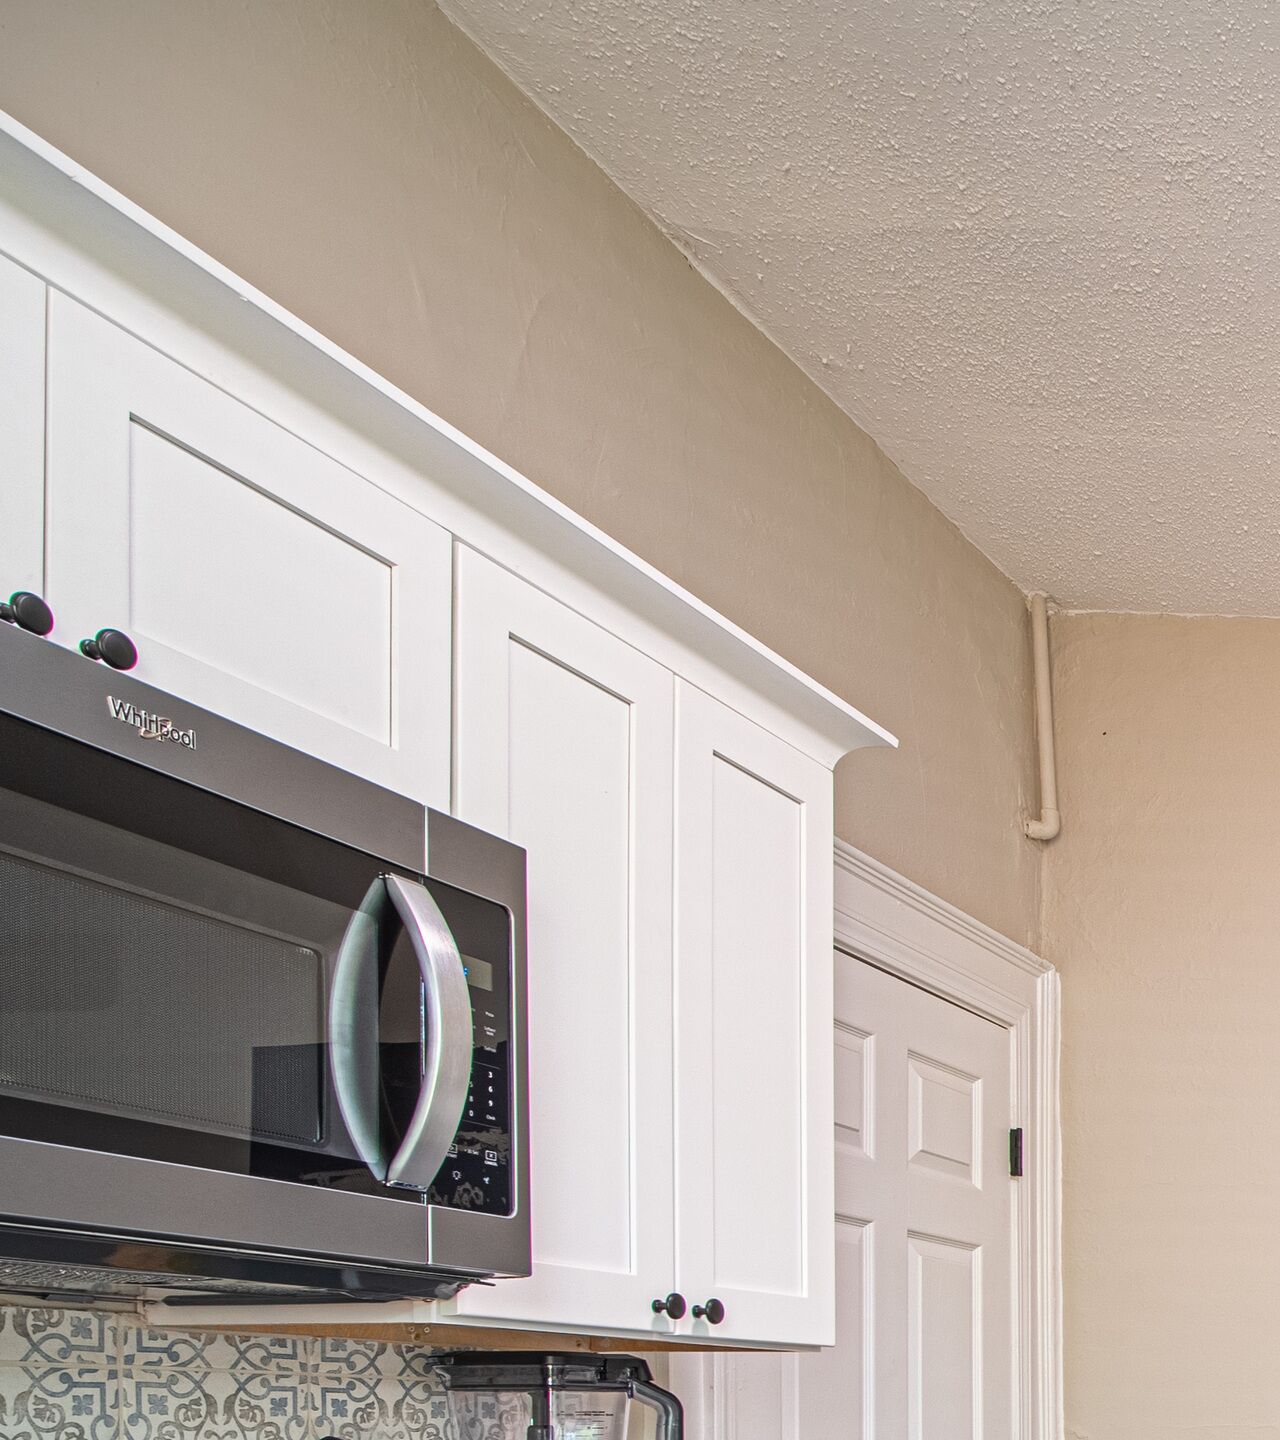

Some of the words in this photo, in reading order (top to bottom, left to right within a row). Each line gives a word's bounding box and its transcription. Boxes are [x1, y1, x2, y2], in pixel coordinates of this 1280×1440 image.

[106, 695, 196, 750] Whirlpool
[487, 1071, 493, 1079] 3
[487, 1085, 493, 1093] 6
